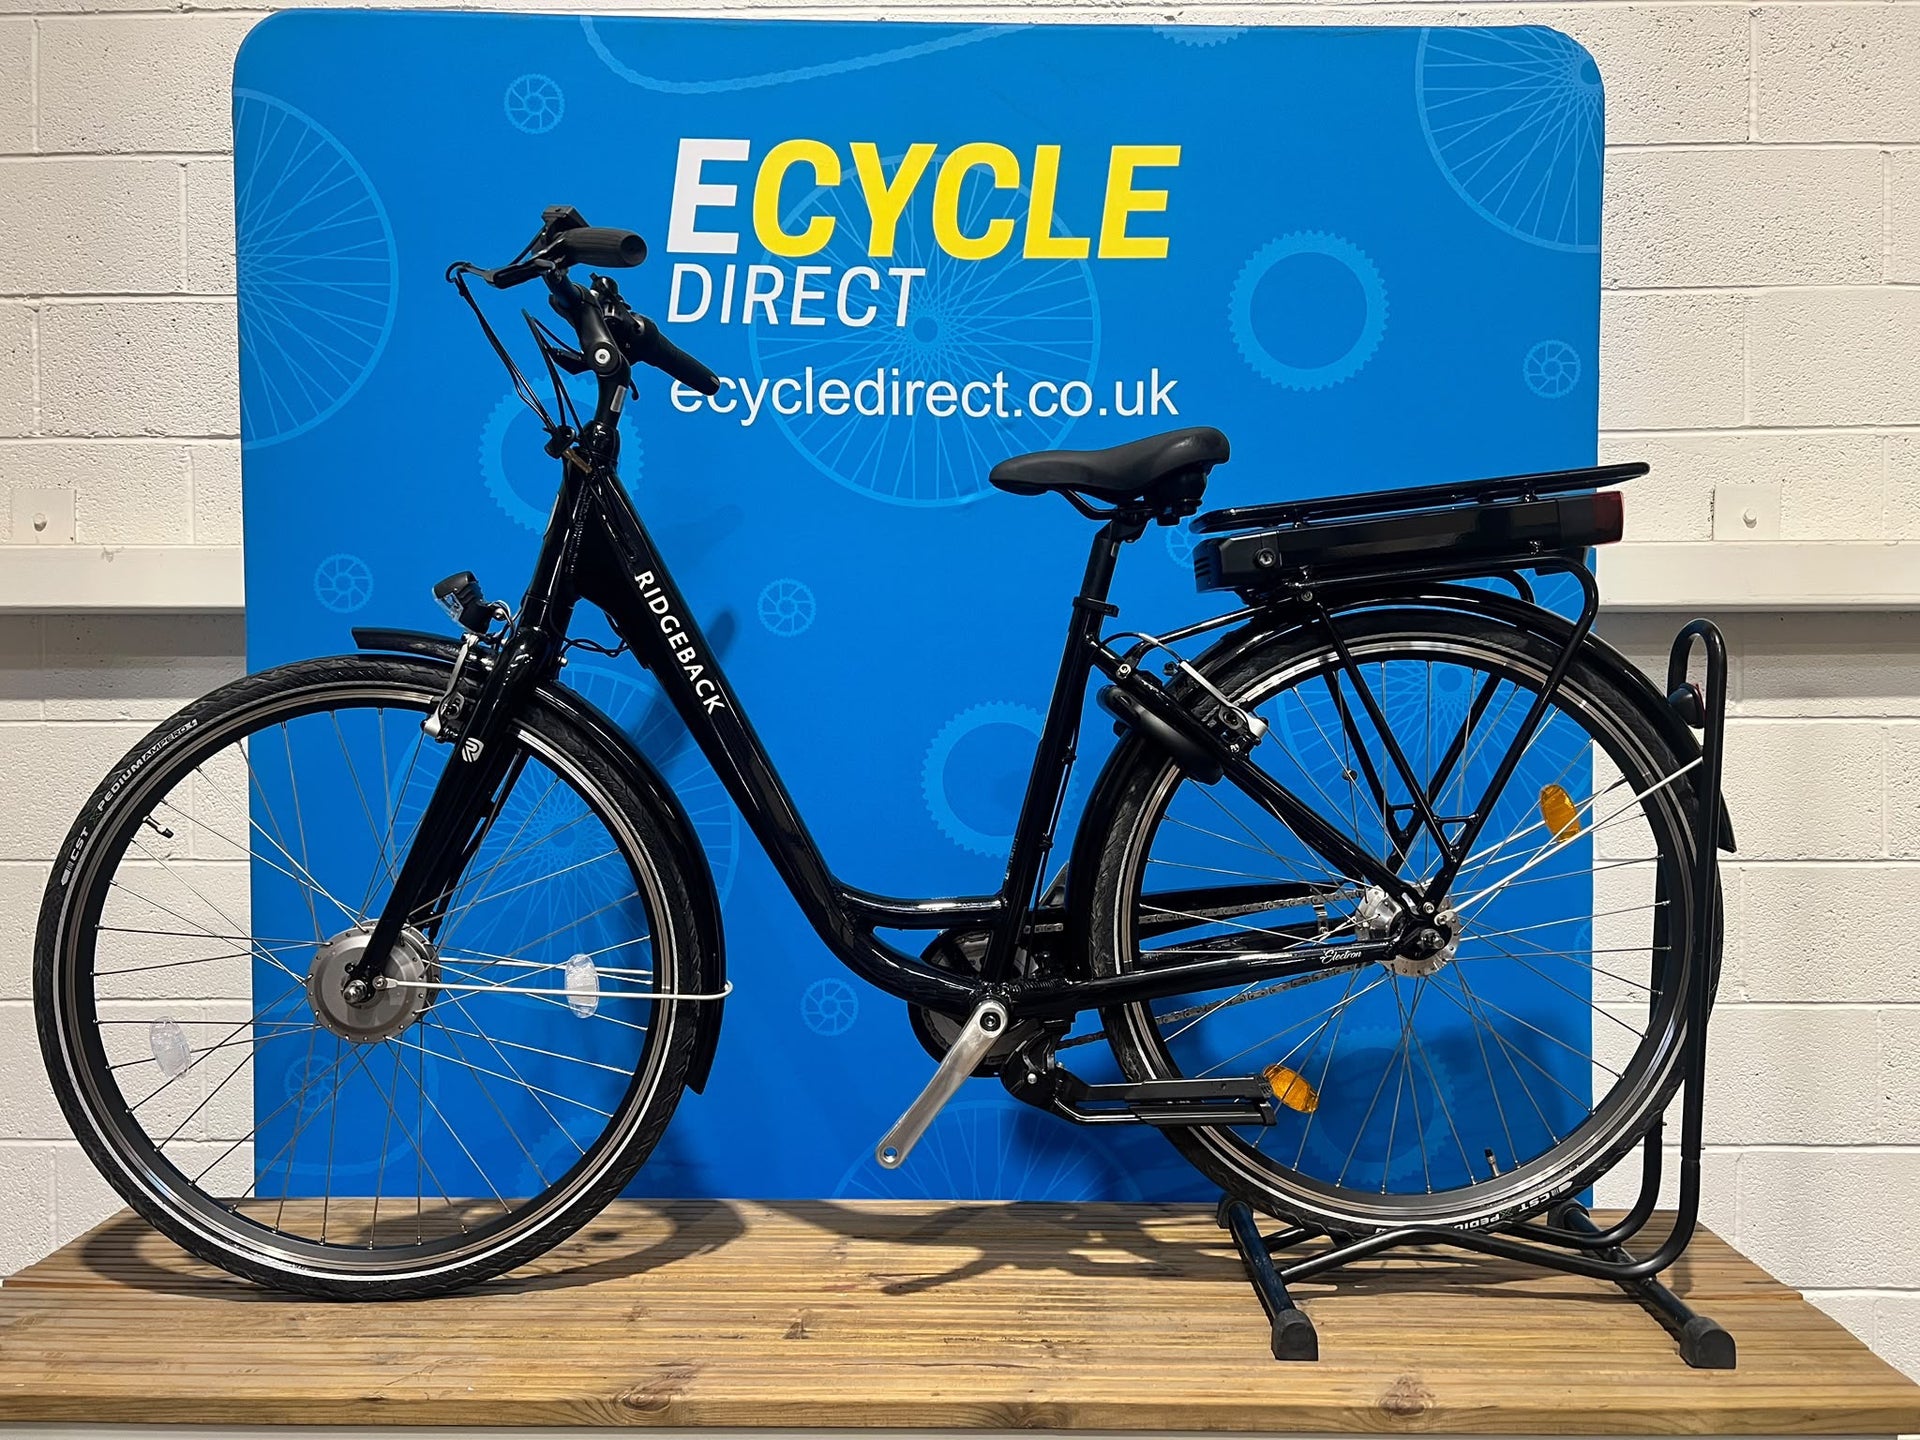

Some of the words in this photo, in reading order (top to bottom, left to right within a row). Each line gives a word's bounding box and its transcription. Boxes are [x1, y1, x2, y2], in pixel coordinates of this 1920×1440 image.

[666, 138, 1181, 260] ECYCLE
[667, 263, 926, 327] DIRECT
[670, 367, 1179, 427] ecycledirect.co.uk
[634, 570, 725, 714] RIDGEBACK
[70, 826, 88, 861] CST
[1320, 949, 1362, 964] Electron
